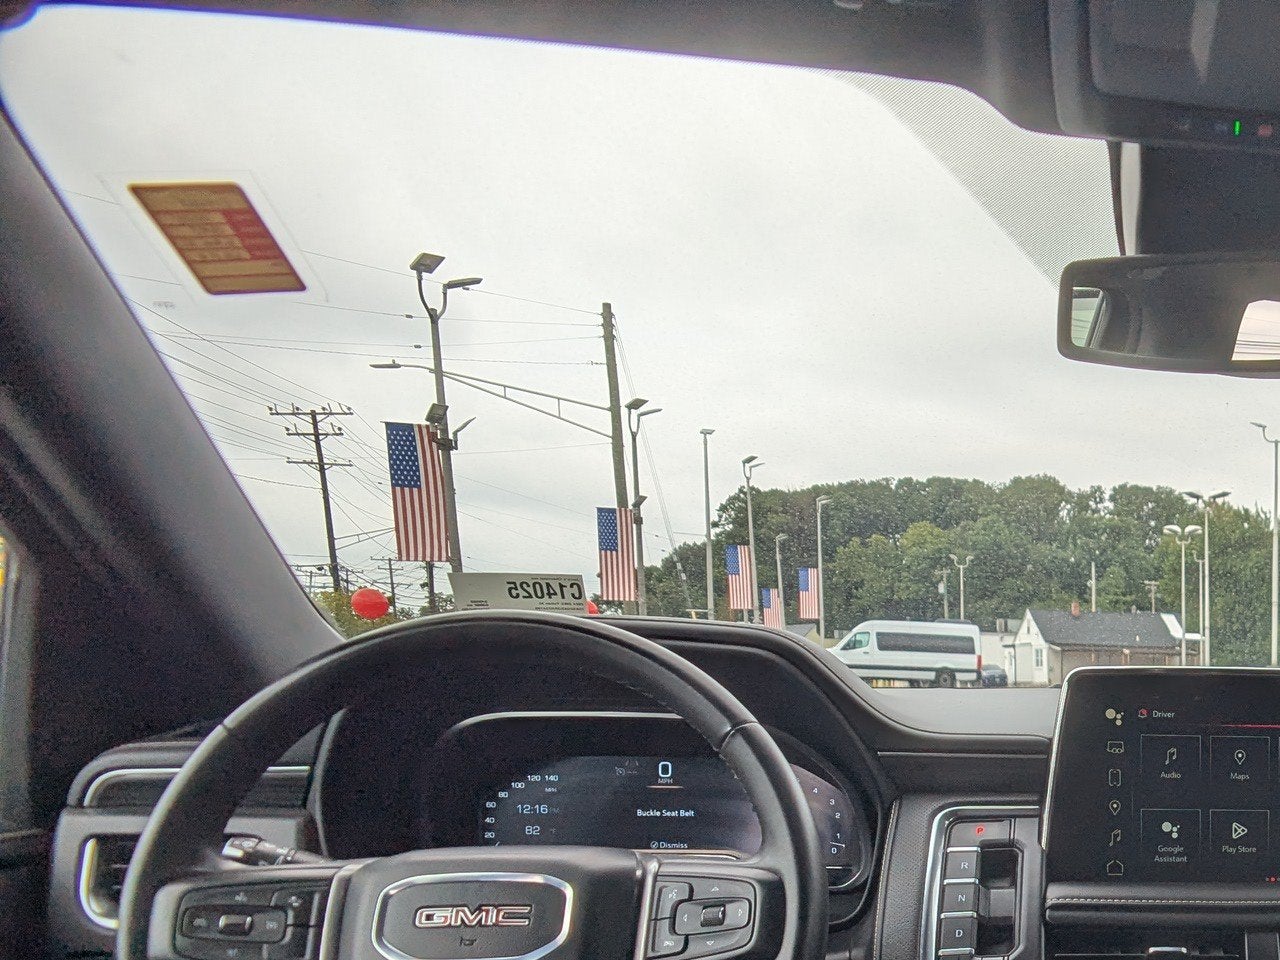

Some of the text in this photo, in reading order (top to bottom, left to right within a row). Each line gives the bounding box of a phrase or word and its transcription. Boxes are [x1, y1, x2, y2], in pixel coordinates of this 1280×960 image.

[1152, 710, 1175, 718] Driver
[658, 761, 672, 778] 0
[1160, 771, 1182, 779] Audio
[1230, 773, 1250, 781] Maps
[829, 798, 835, 806] 3
[517, 804, 548, 814] 12:16
[637, 809, 695, 817] Buckle Seat Belt
[525, 825, 540, 835] 82
[484, 831, 496, 839] 20
[660, 841, 688, 849] Dismiss
[1157, 845, 1184, 854] Google
[1222, 845, 1257, 854] Play Store
[415, 906, 532, 928] GMC
[956, 930, 963, 938] D
